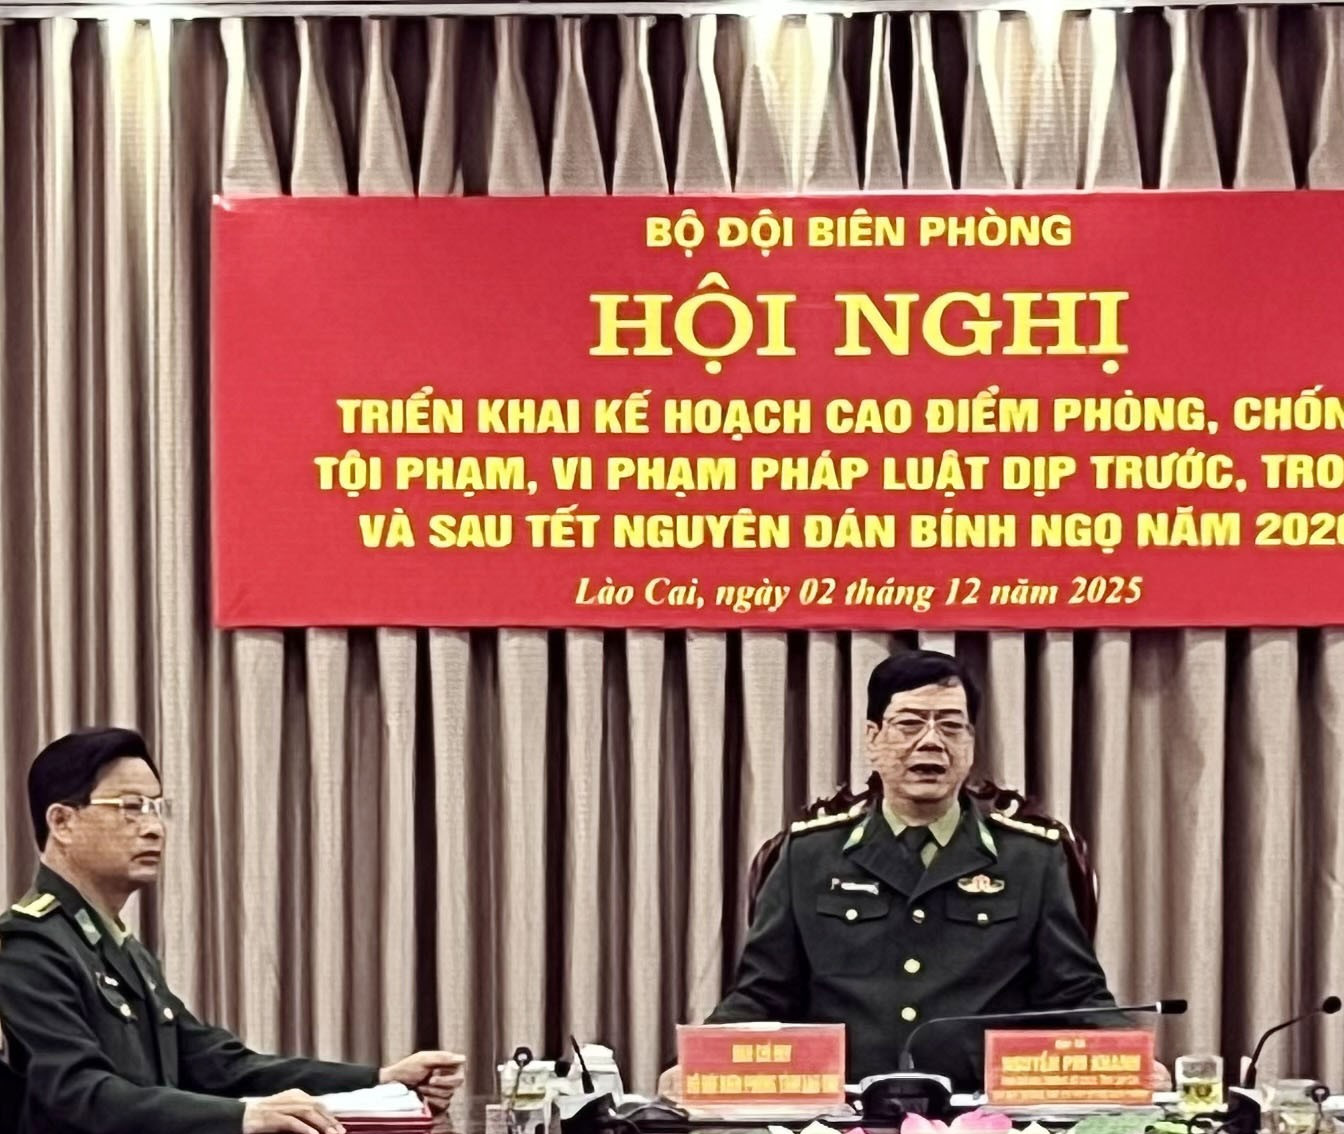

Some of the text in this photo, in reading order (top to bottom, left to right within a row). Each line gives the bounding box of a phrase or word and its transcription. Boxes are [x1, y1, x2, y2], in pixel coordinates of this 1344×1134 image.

[647, 207, 1071, 257] BỘ ĐỘI BIÊN PHÒNG
[589, 272, 1129, 374] HỘI NGHỊ
[336, 386, 463, 433] TRIỂN
[478, 399, 579, 433] KHAI
[595, 388, 651, 433] KẾ
[665, 399, 811, 442] HOẠCH
[826, 399, 912, 433] CAO
[925, 385, 1038, 433] ĐIỂM
[1054, 390, 1218, 435] PHÒNG,
[314, 449, 381, 499] TỘI
[396, 457, 537, 498] PHẠM,
[552, 457, 592, 490] VI
[608, 457, 736, 499] PHẠM
[751, 450, 868, 490] PHÁP
[884, 449, 989, 499] LUẬT
[1003, 456, 1076, 499] DỊP
[1090, 448, 1246, 493] TRƯỚC,
[359, 508, 415, 547] VÀ
[429, 515, 512, 548] SAU
[525, 502, 600, 548] TẾT
[614, 508, 789, 548] NGUYÊN
[804, 508, 895, 548] ĐÁN
[911, 508, 1015, 548] BÍNH
[1031, 513, 1122, 556] NGỌ
[1137, 506, 1240, 547] NĂM
[576, 576, 1143, 614] Lào Cai, ngày 02 tháng 12 năm 2025
